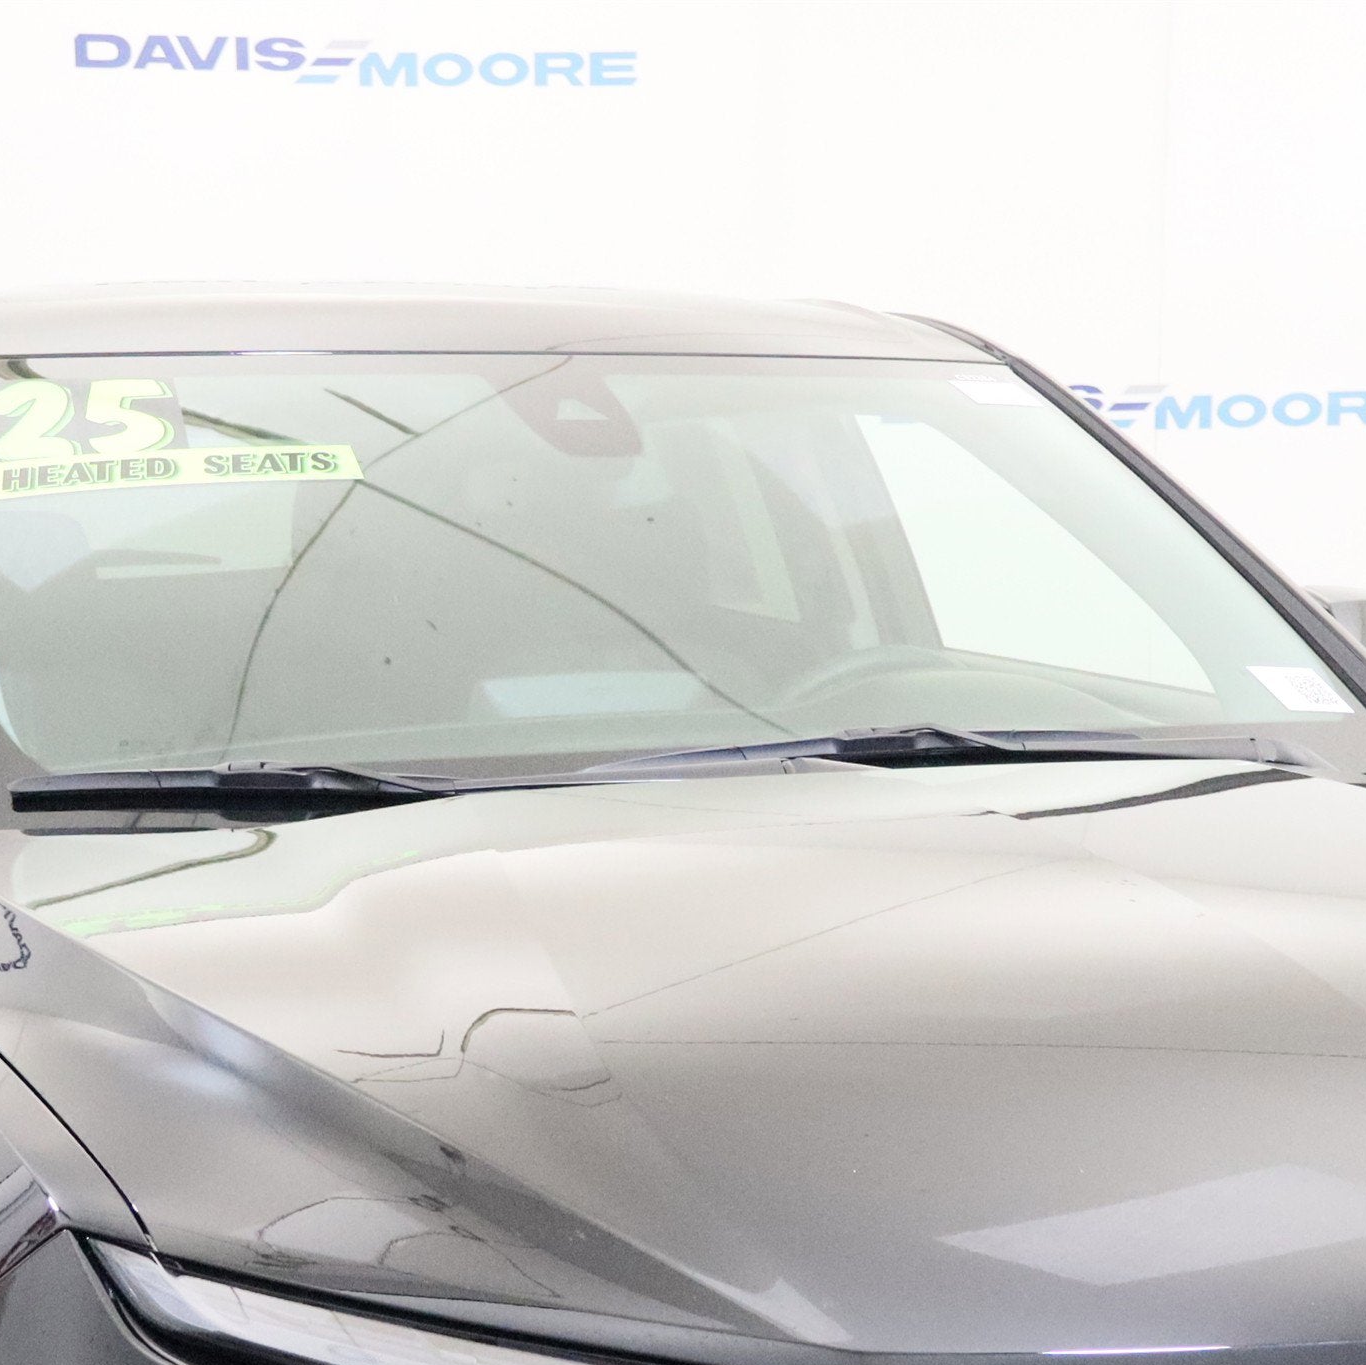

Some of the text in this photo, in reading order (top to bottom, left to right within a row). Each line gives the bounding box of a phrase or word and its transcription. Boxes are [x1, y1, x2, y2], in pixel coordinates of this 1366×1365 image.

[74, 33, 638, 87] DAVIS MOORE
[2, 450, 340, 492] HEATED SEATS
